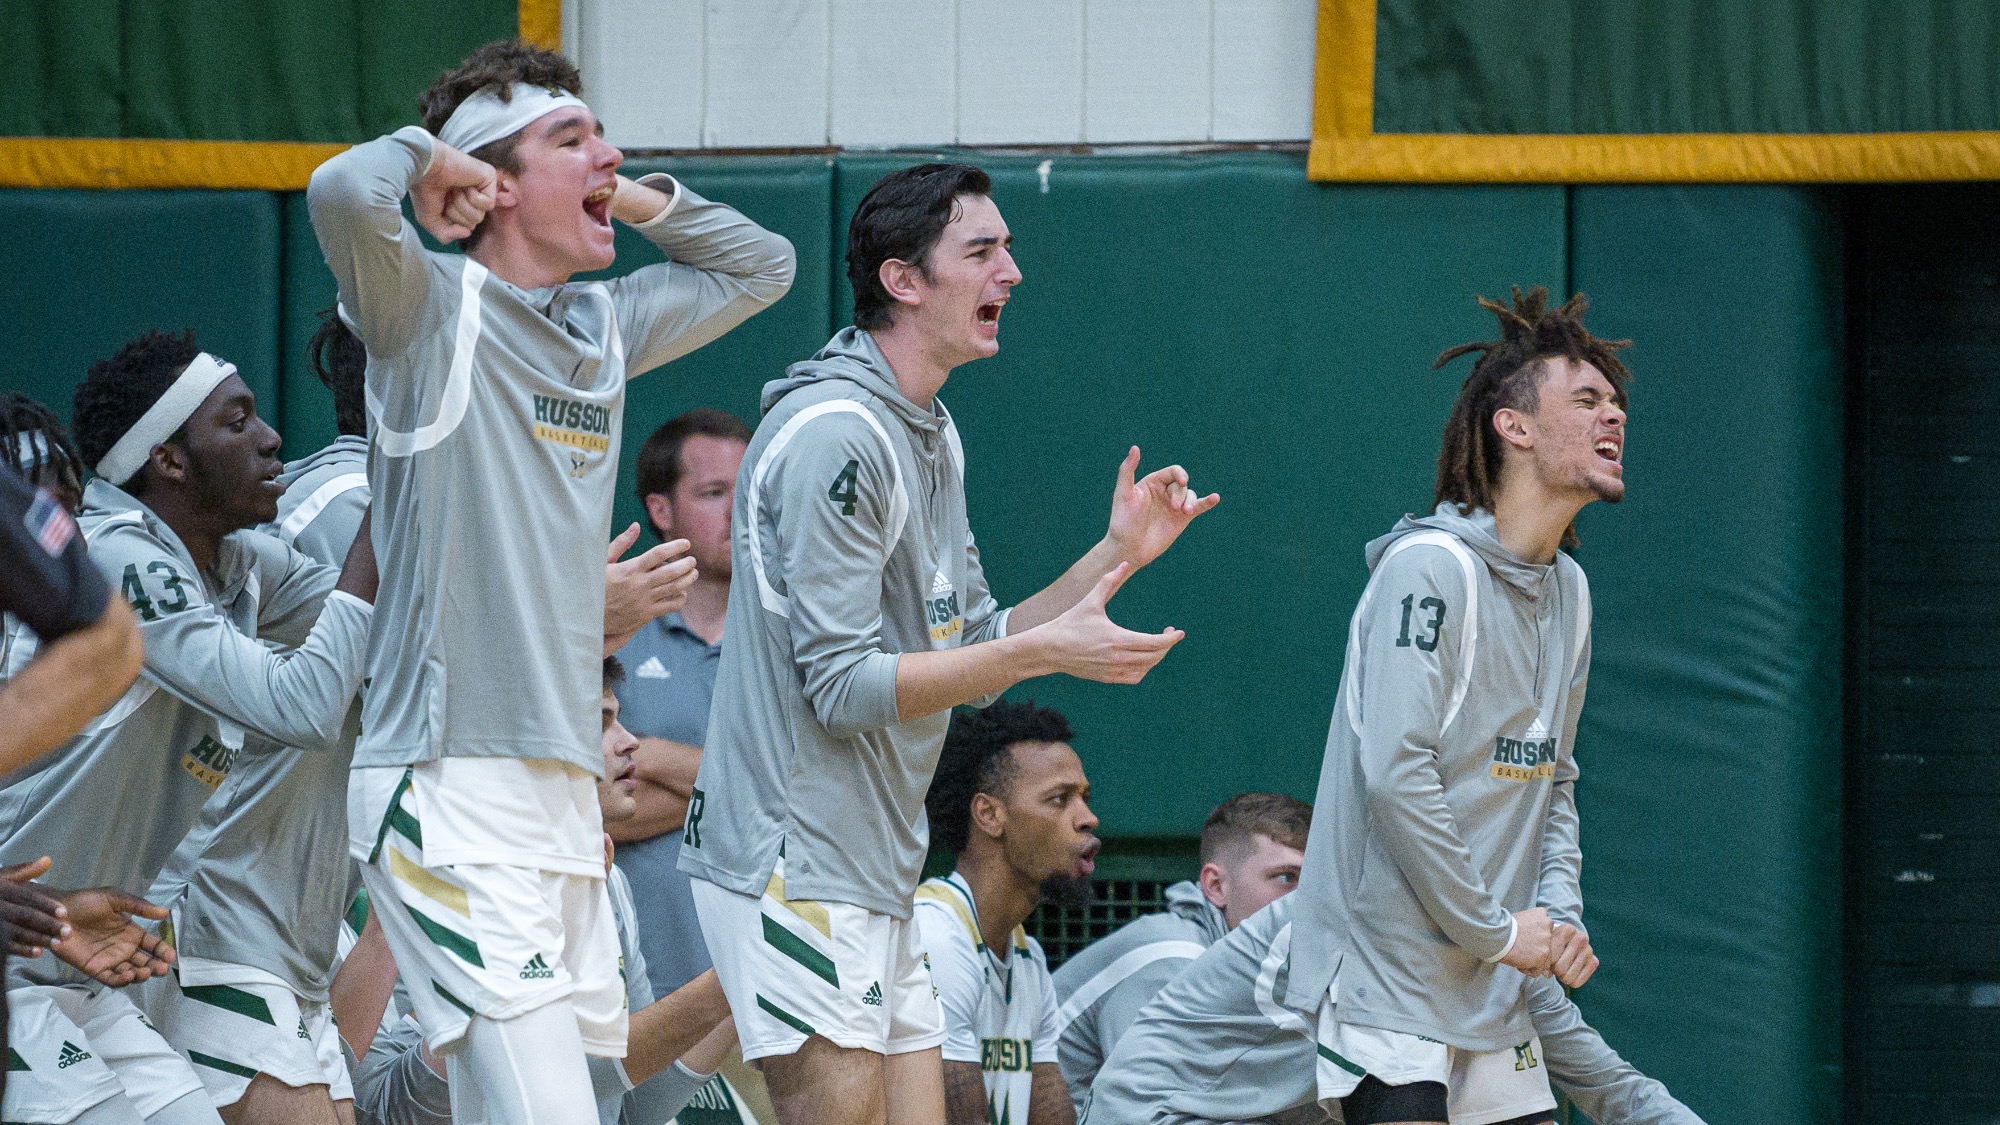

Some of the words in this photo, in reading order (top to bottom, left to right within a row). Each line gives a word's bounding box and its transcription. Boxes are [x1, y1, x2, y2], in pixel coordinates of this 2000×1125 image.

[533, 393, 610, 435] HUSSON
[828, 459, 859, 516] 4
[121, 560, 188, 621] 43
[1395, 593, 1446, 652] 13
[519, 969, 554, 980] adidas
[58, 1052, 92, 1070] adidas
